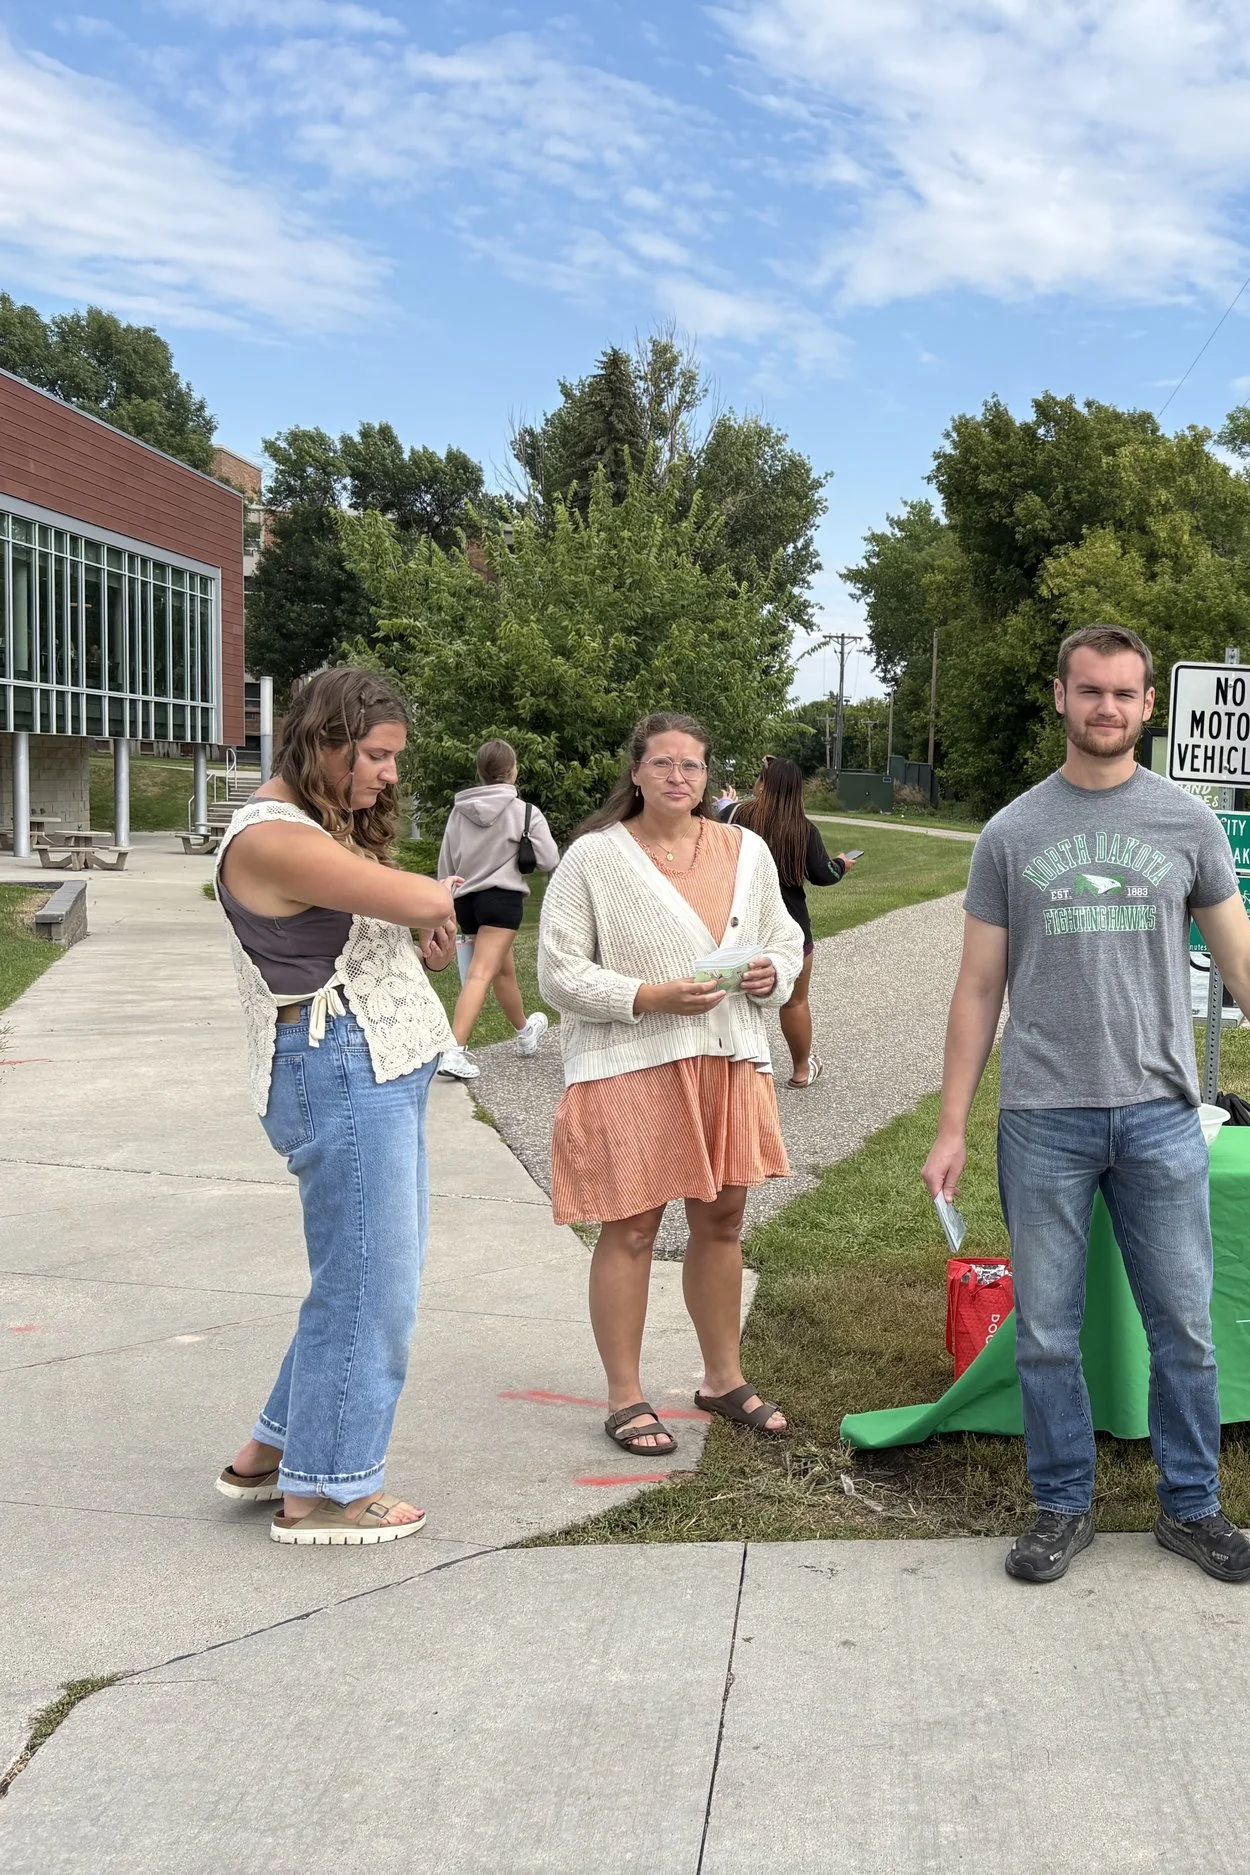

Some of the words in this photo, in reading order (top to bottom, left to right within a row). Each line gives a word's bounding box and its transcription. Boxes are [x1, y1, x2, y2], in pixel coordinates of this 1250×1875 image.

[1215, 677, 1246, 707] NO
[1022, 833, 1091, 891] NORTH
[1095, 831, 1174, 887] DAKOTA
[1051, 889, 1073, 900] EST.
[1127, 887, 1149, 896] 1883
[1043, 906, 1107, 935] FIGHTING
[1108, 905, 1157, 932] HAWKS
